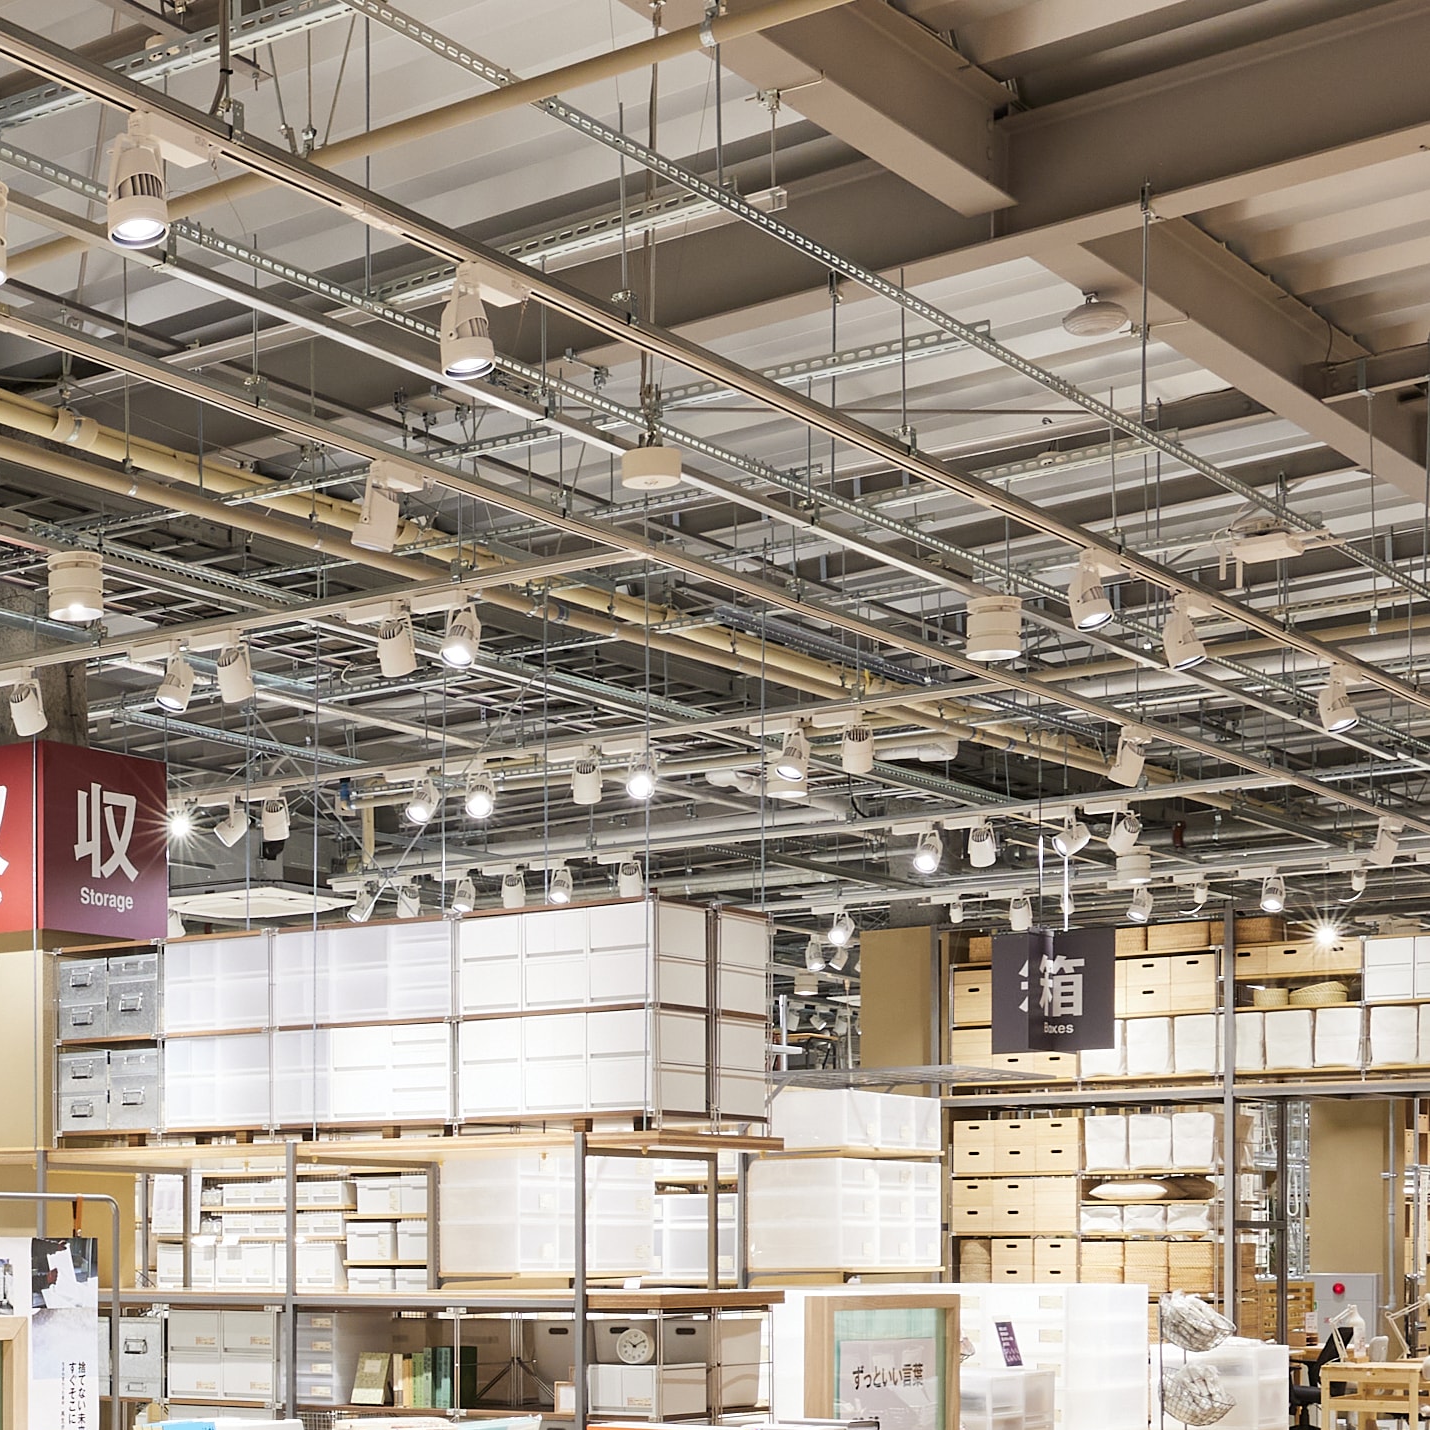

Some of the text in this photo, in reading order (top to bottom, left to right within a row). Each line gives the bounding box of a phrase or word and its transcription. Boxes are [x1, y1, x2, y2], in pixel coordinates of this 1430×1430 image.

[73, 782, 140, 882] 収
[80, 886, 134, 913] Storage
[69, 1362, 77, 1424] すぐそこに
[852, 1363, 924, 1390] ずっといい言葉
